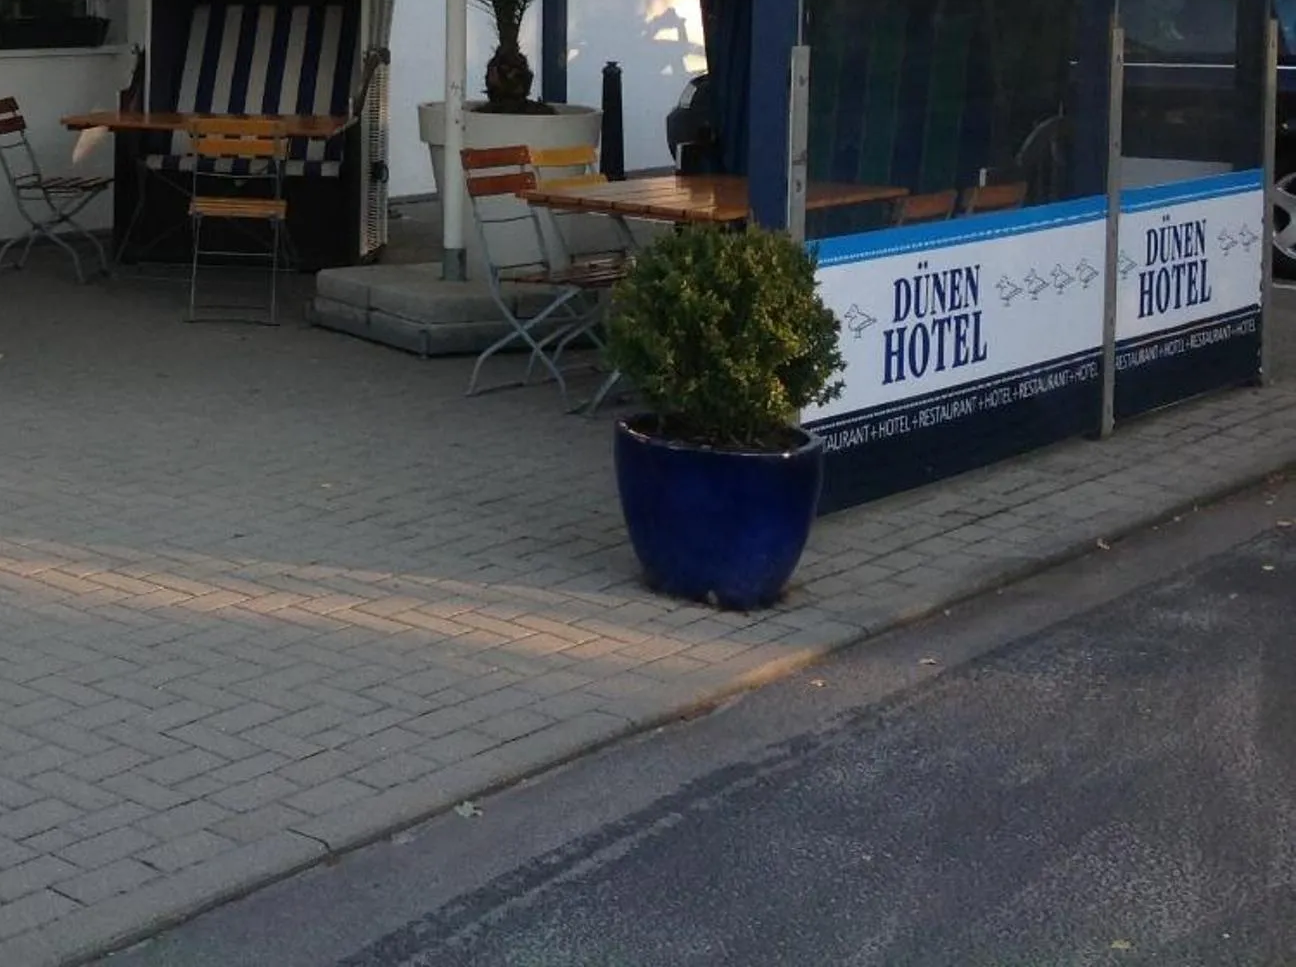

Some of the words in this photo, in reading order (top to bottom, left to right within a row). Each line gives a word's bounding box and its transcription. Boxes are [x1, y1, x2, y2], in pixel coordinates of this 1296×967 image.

[1145, 214, 1208, 266] DÜNEN
[893, 261, 981, 323] DÜNEN
[1137, 259, 1212, 319] HOTEL
[882, 311, 988, 385] HOTEL
[879, 415, 911, 439] HOTEL
[919, 396, 977, 428] RESTAURANT
[984, 387, 1013, 410] HOTEL
